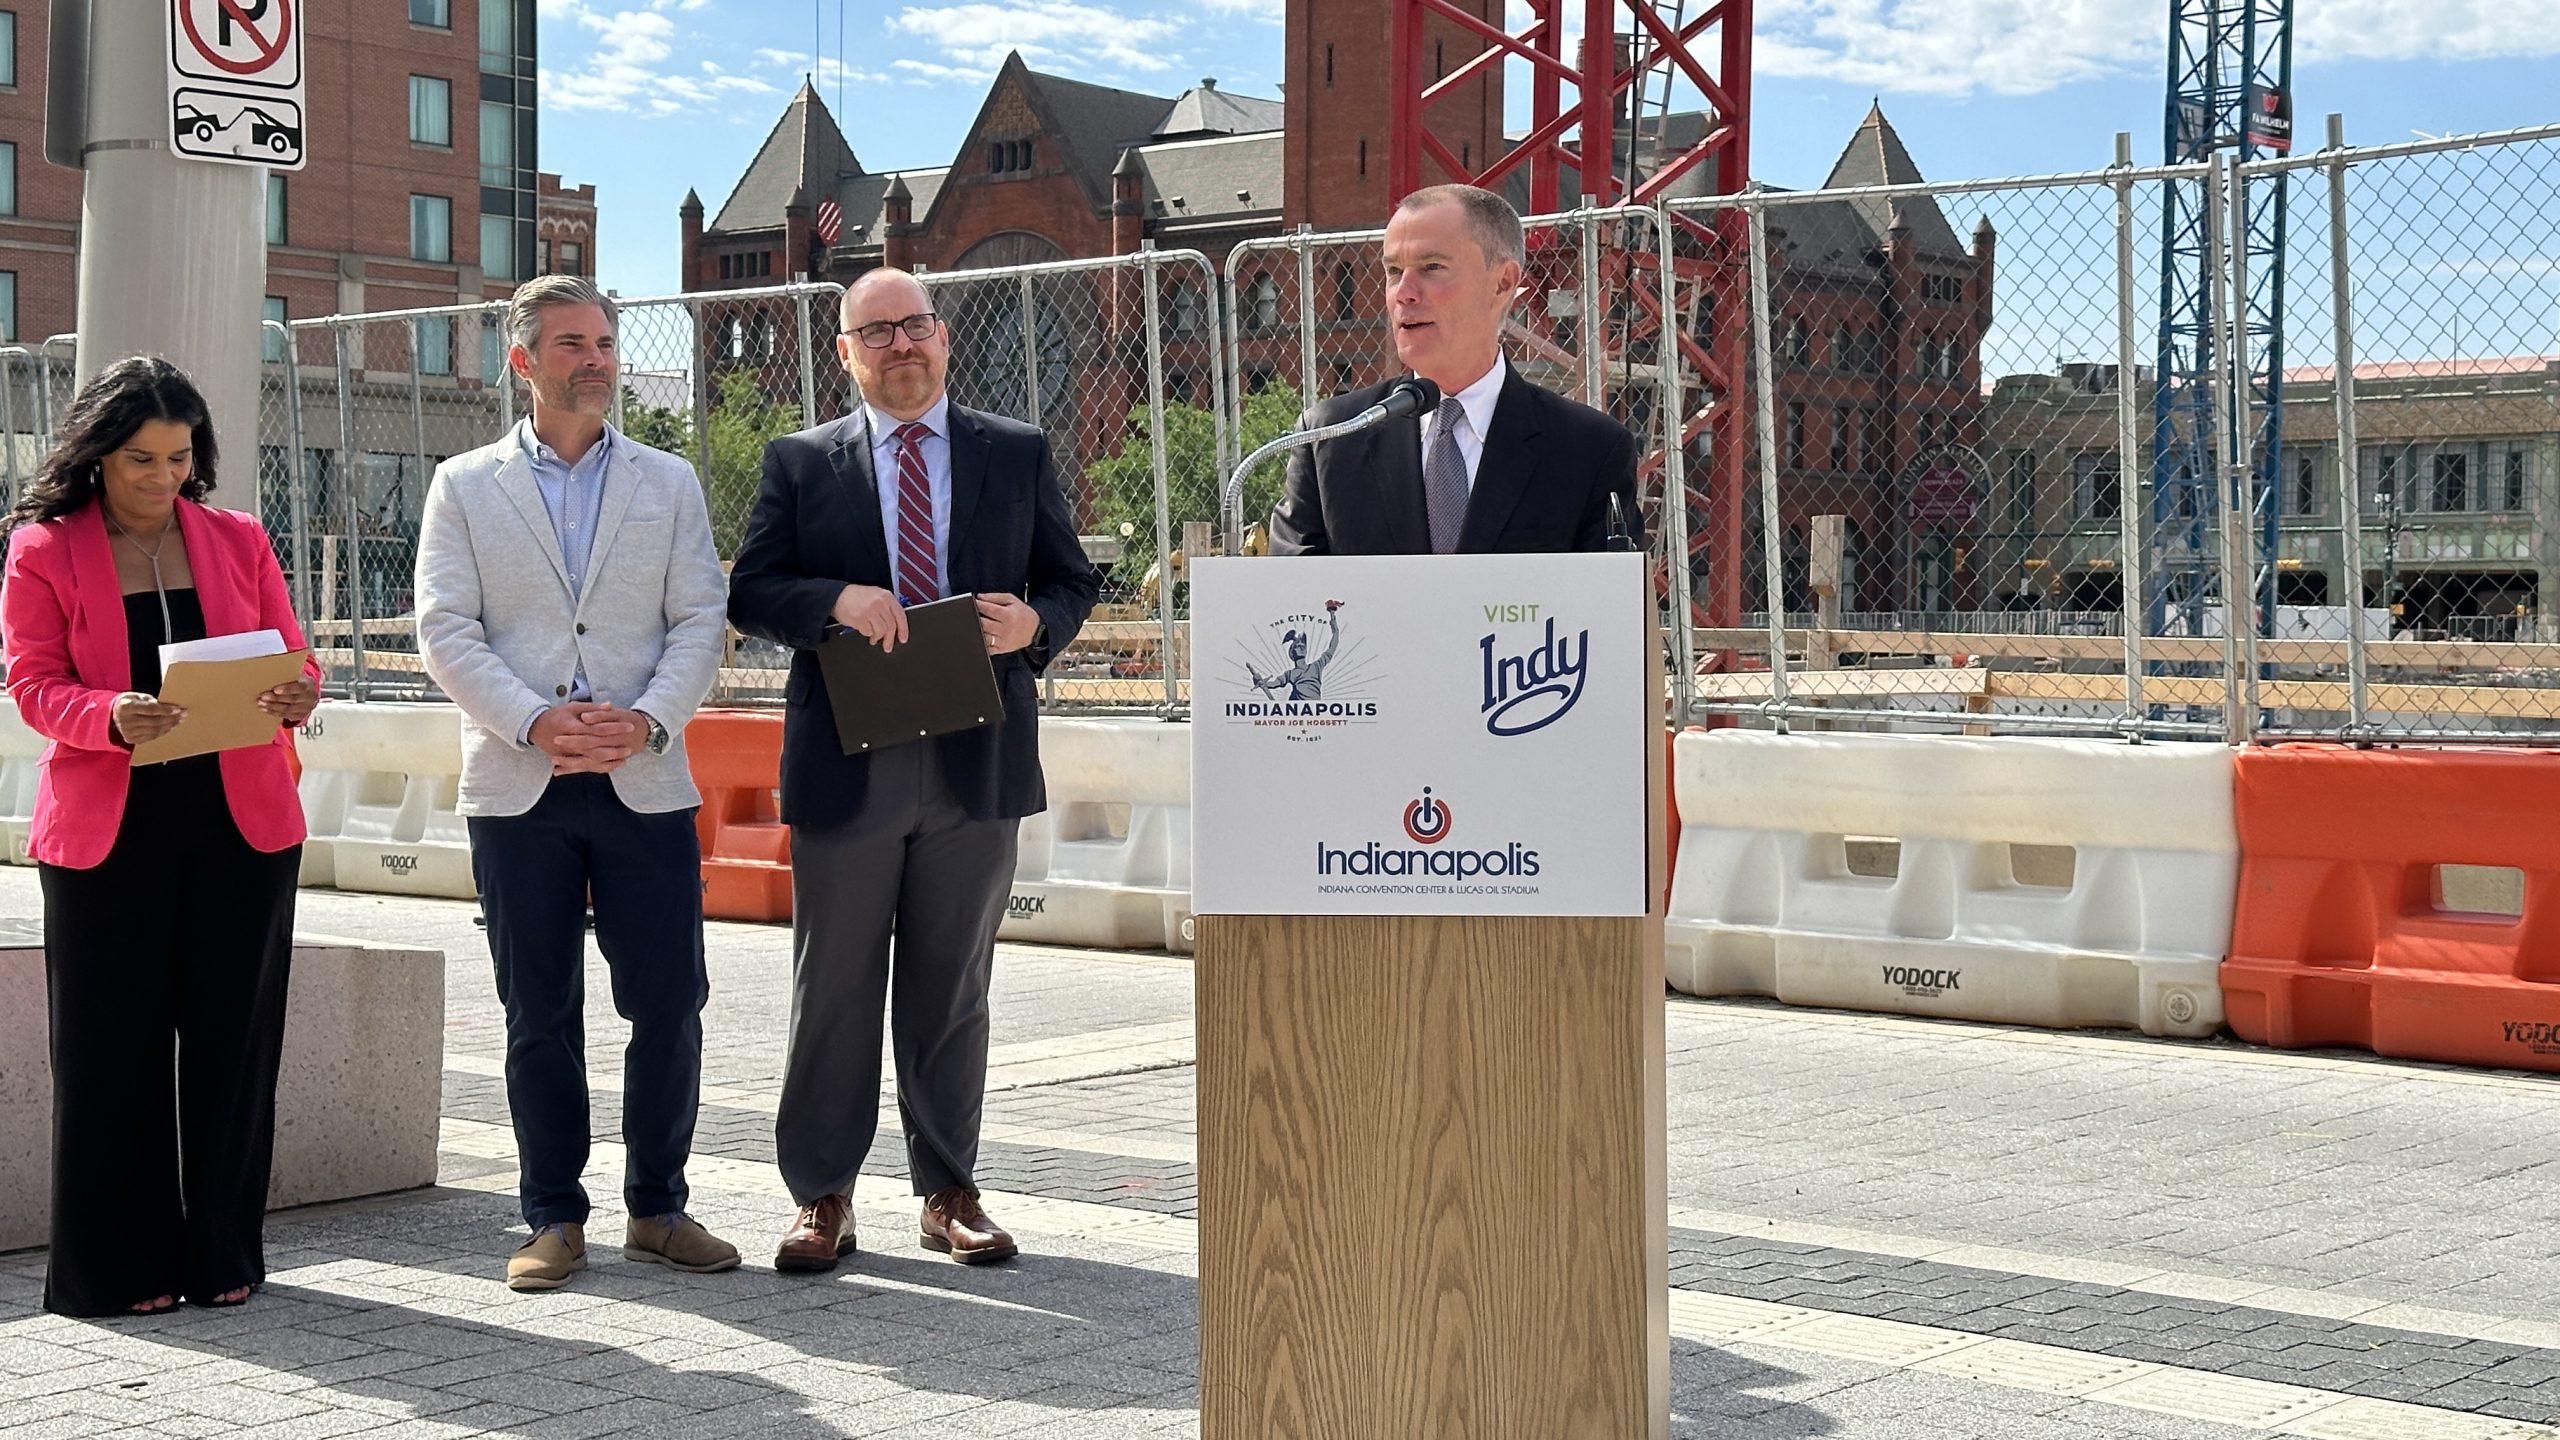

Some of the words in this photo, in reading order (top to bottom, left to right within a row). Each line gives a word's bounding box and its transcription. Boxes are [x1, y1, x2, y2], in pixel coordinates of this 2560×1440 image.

[1269, 619, 1285, 628] THE
[1287, 614, 1315, 623] CITY
[1483, 604, 1540, 623] VISIT
[1479, 616, 1588, 737] Indy
[1225, 702, 1377, 717] INDIANAPOLIS
[1254, 719, 1286, 727] MAYOR
[1288, 719, 1304, 727] JOE
[1306, 719, 1349, 727] HOGSETT
[380, 854, 418, 870] YODOCK
[1317, 841, 1540, 881] Indianapolis
[1317, 884, 1355, 894] INDIANA
[1355, 884, 1414, 895] CONVENTION
[1415, 885, 1447, 895] CENTER
[1447, 885, 1455, 894] &
[1456, 885, 1484, 895] LUCAS
[1485, 885, 1500, 895] OIL
[1500, 885, 1540, 895] STADIUM
[1009, 895, 1046, 913] DOCK
[1881, 964, 1961, 990] YODOCK
